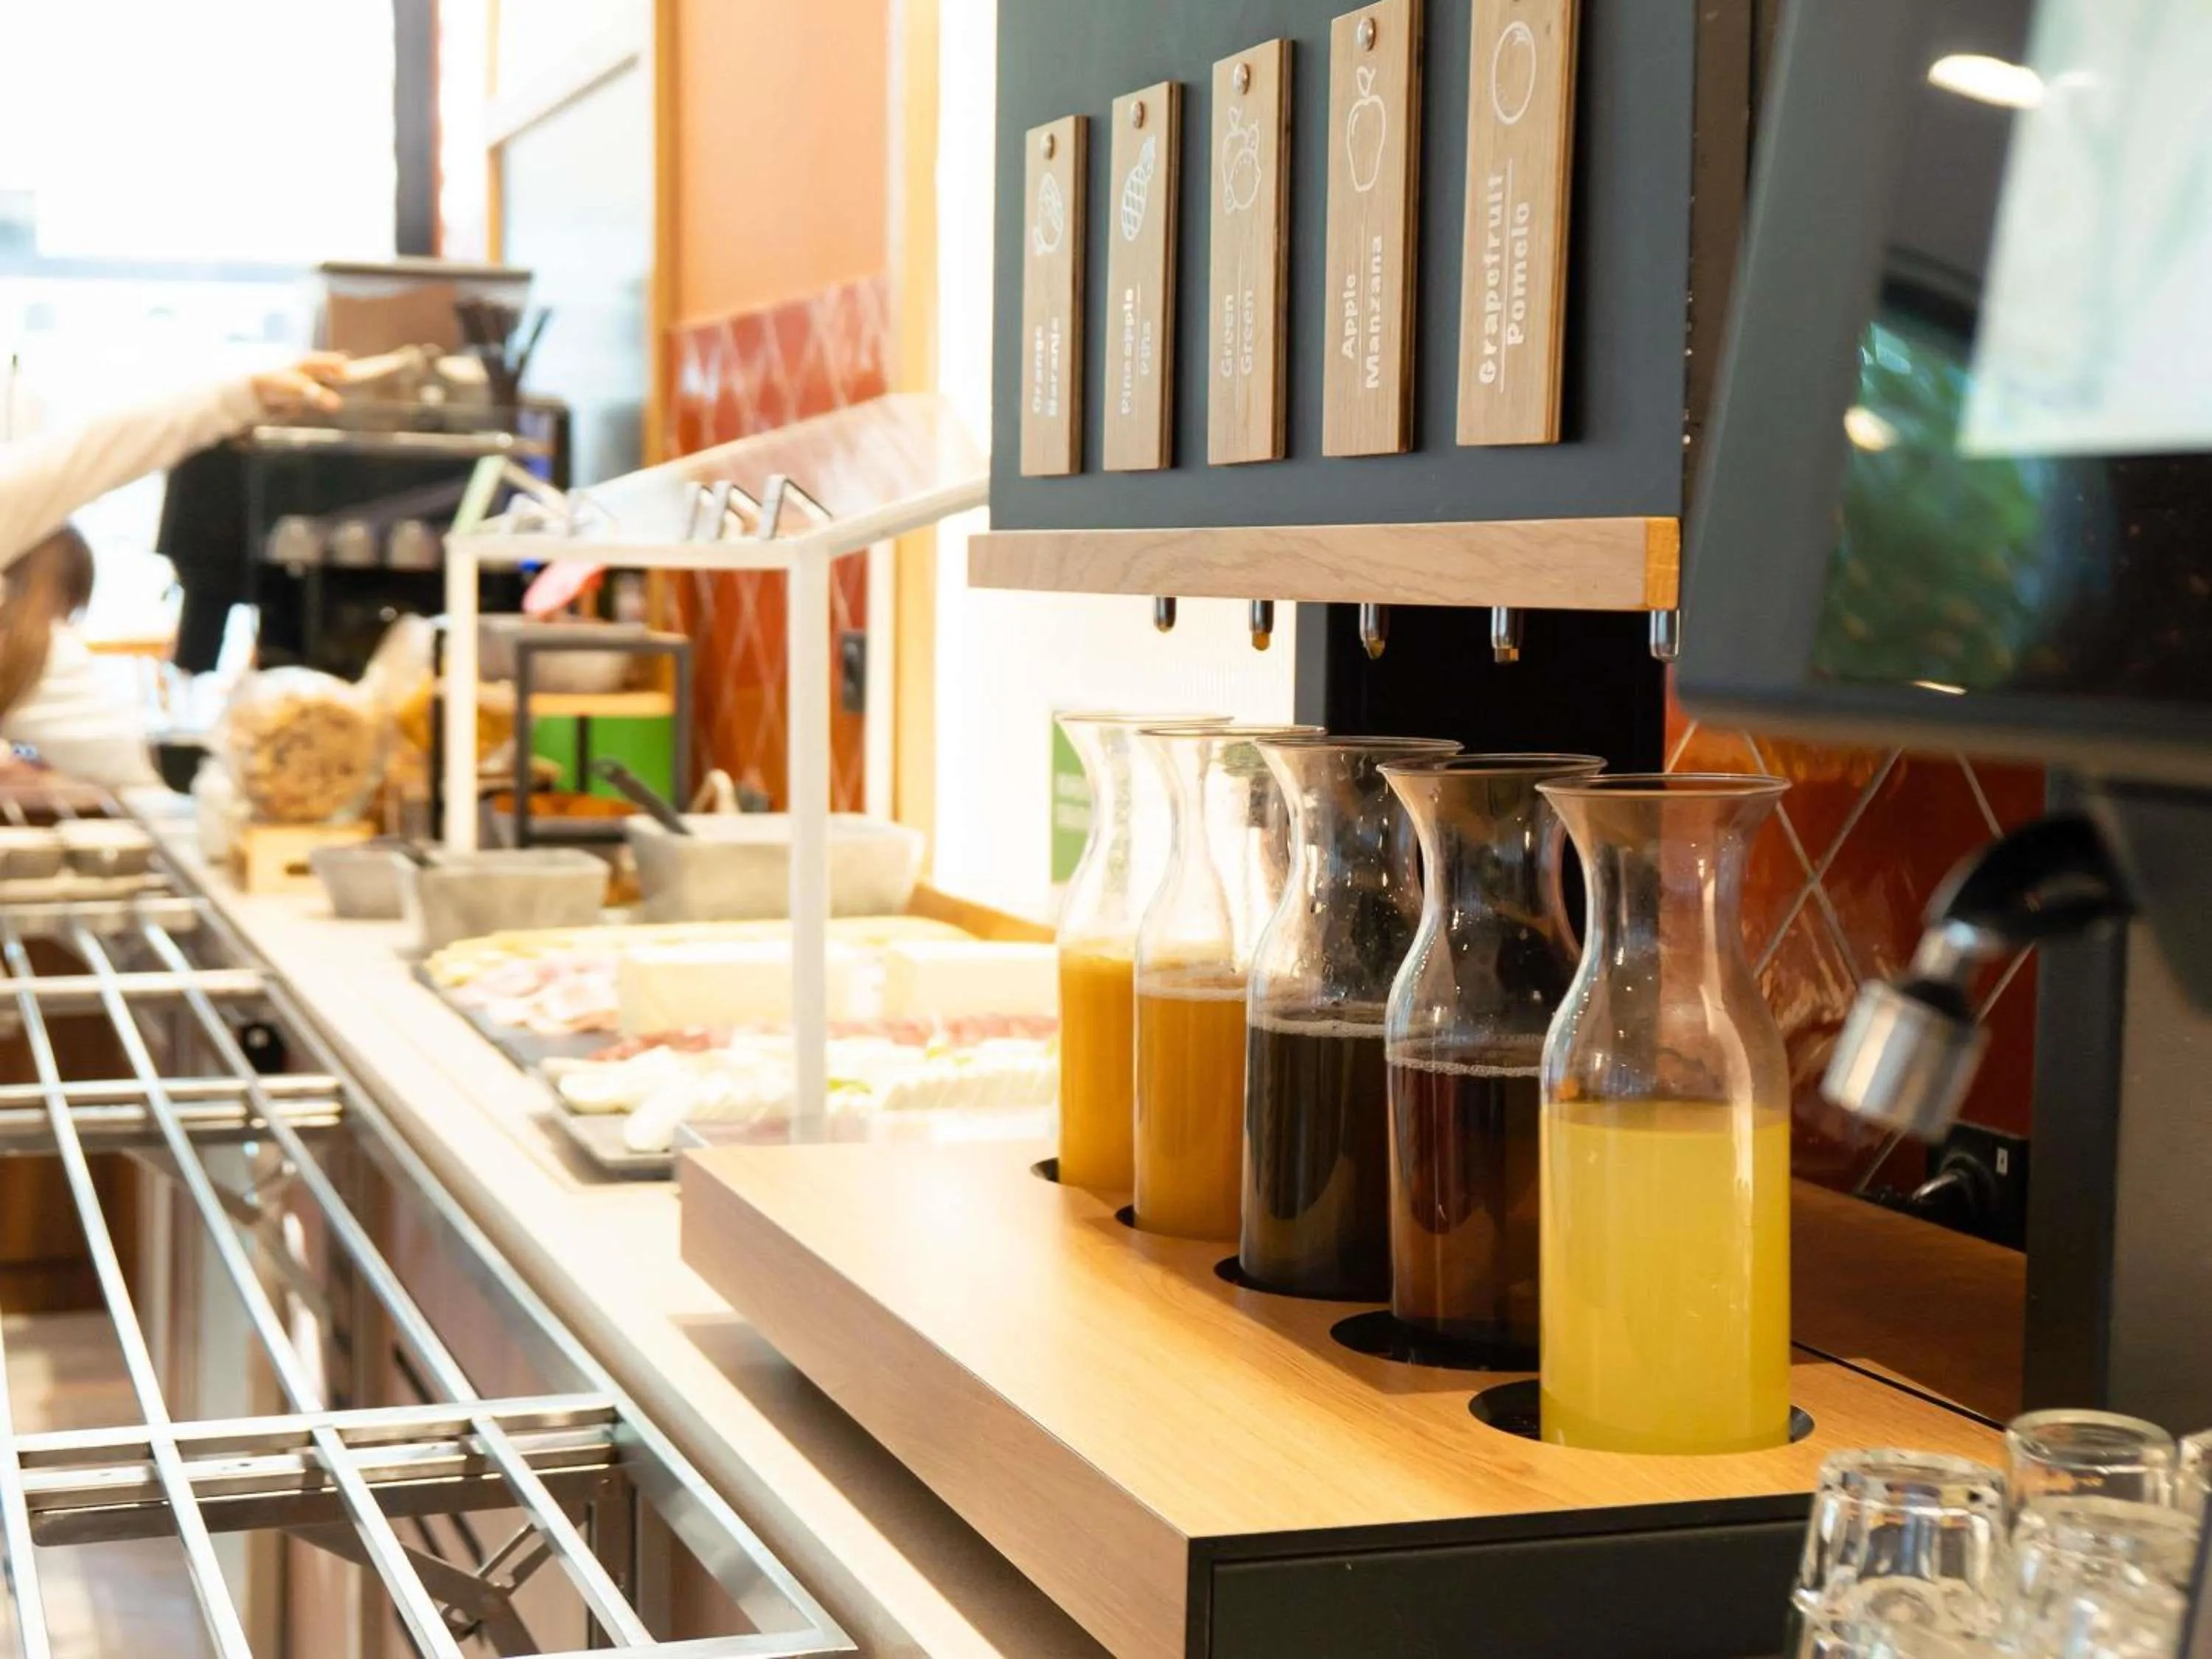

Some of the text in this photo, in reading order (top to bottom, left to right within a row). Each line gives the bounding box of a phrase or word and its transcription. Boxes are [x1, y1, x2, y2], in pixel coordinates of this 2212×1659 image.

[1239, 288, 1253, 375] Green
[1340, 273, 1357, 359] Apple
[1365, 235, 1382, 389] Manzana
[1478, 173, 1504, 385] Grapefruit
[1505, 201, 1530, 346] Pomelo
[1220, 293, 1234, 378] Green
